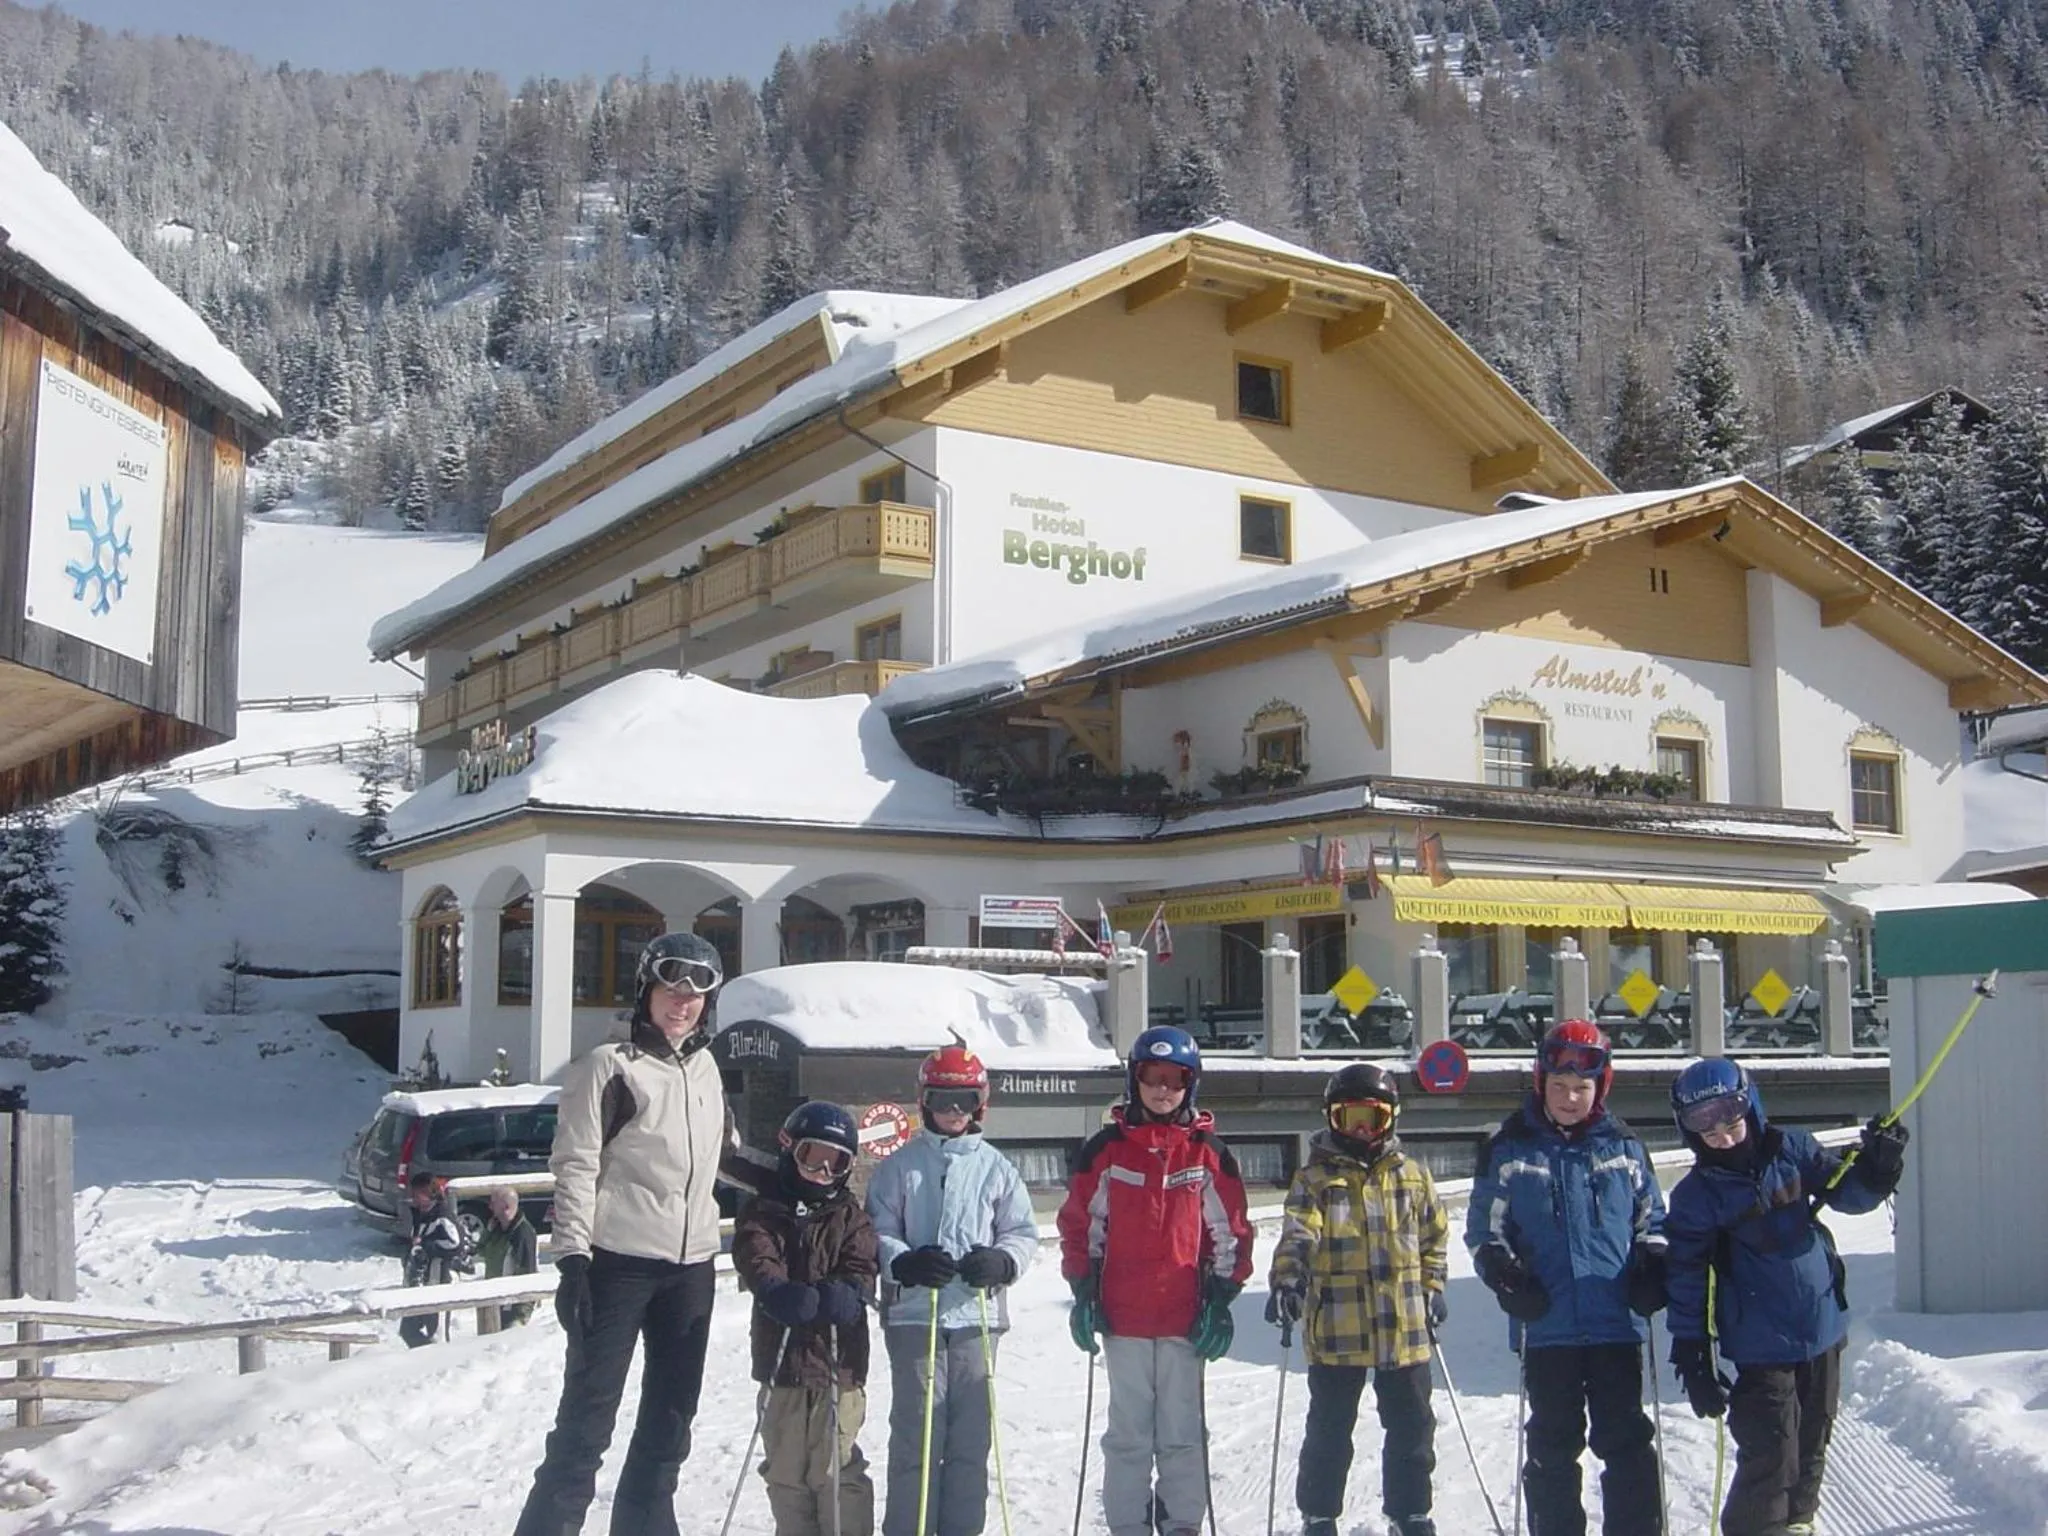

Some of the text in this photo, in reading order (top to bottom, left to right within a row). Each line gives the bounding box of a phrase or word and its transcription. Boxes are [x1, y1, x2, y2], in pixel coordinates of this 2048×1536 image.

[1032, 513, 1085, 537] Hotel
[1003, 529, 1147, 584] Berghof
[1564, 703, 1634, 723] RESTAURANT
[1457, 902, 1561, 919] HAUSMANNSKOST
[863, 1104, 908, 1130] AUSTRIA
